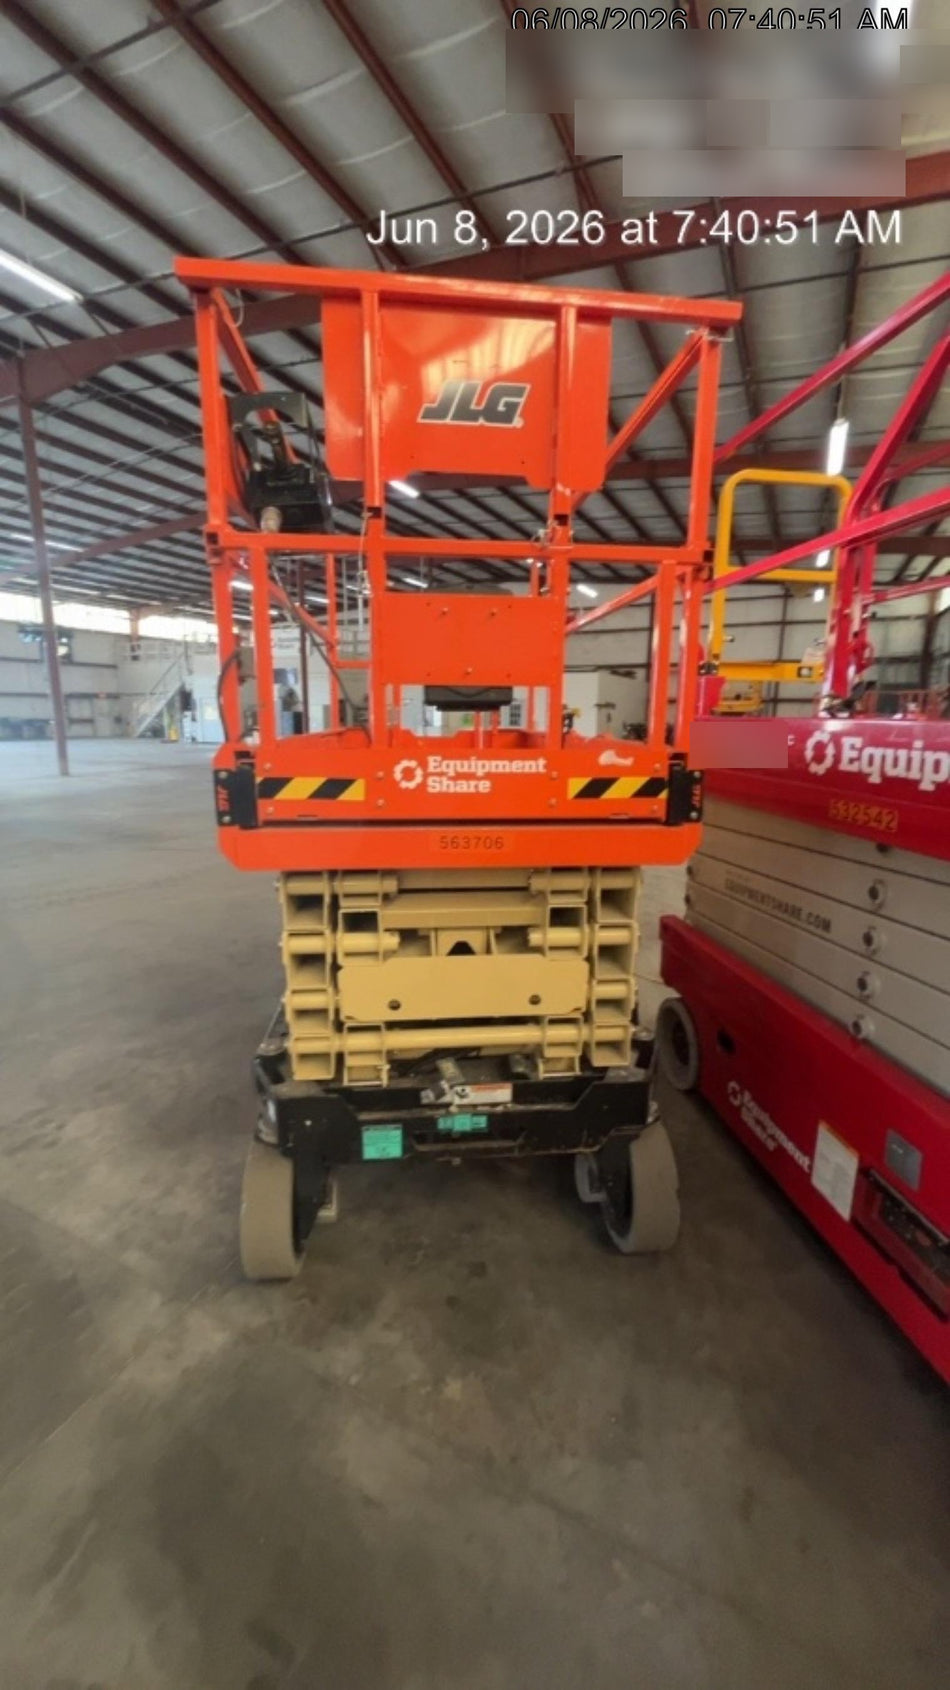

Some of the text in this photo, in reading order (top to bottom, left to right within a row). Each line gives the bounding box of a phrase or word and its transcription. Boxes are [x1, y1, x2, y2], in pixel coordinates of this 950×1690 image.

[417, 380, 531, 427] JLG
[427, 755, 548, 777] Equipment
[427, 775, 492, 793] Share
[439, 834, 505, 850] 563706
